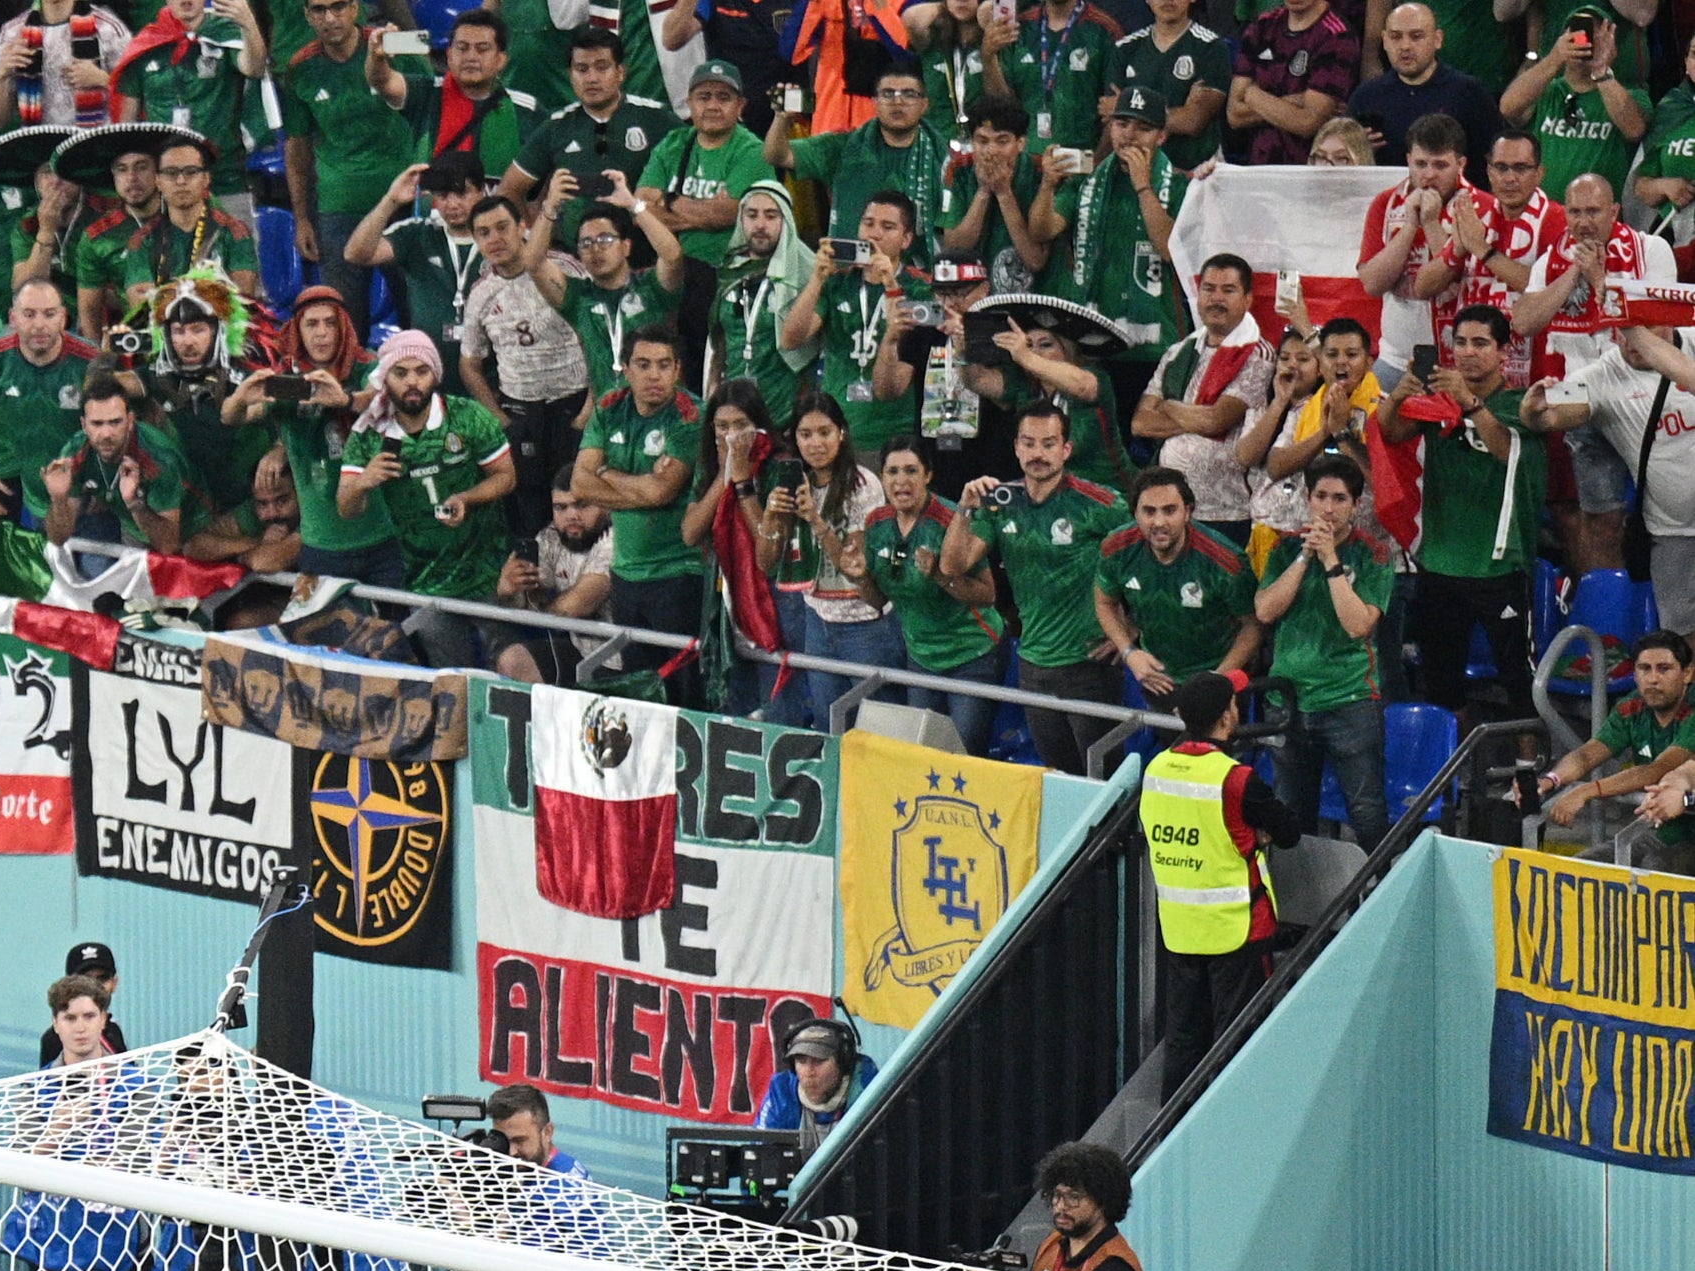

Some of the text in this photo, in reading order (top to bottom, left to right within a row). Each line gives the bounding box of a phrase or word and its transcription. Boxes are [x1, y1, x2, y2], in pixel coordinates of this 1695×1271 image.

[516, 324, 535, 348] 8
[421, 475, 439, 505] 1
[120, 697, 257, 826] LYL
[489, 687, 826, 846] TRES
[1151, 824, 1200, 846] 0948
[96, 815, 283, 896] ENEMIGOS
[1154, 852, 1204, 872] Security
[366, 828, 434, 929] DOUBLE
[904, 954, 944, 978] LIBRES
